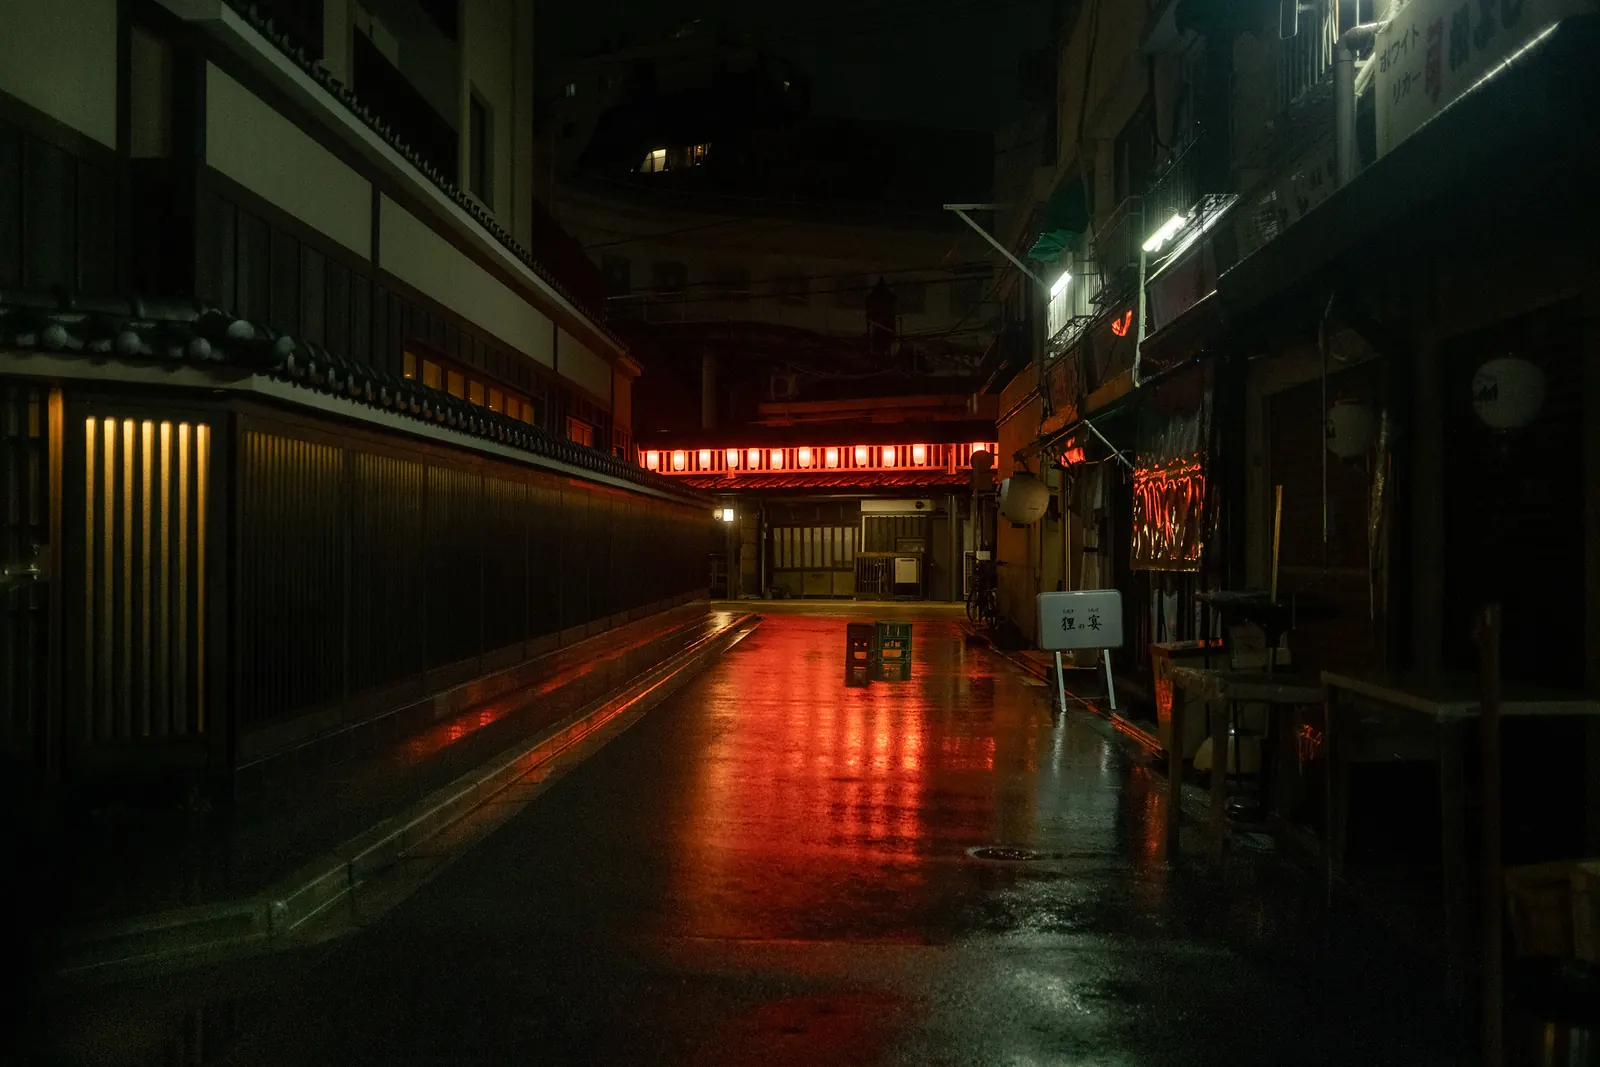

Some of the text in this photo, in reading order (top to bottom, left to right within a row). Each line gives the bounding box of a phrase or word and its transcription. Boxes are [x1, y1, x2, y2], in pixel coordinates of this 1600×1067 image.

[1380, 24, 1419, 73] ホワイト
[1393, 71, 1421, 105] リカー
[1061, 614, 1102, 631] 狸の宴
